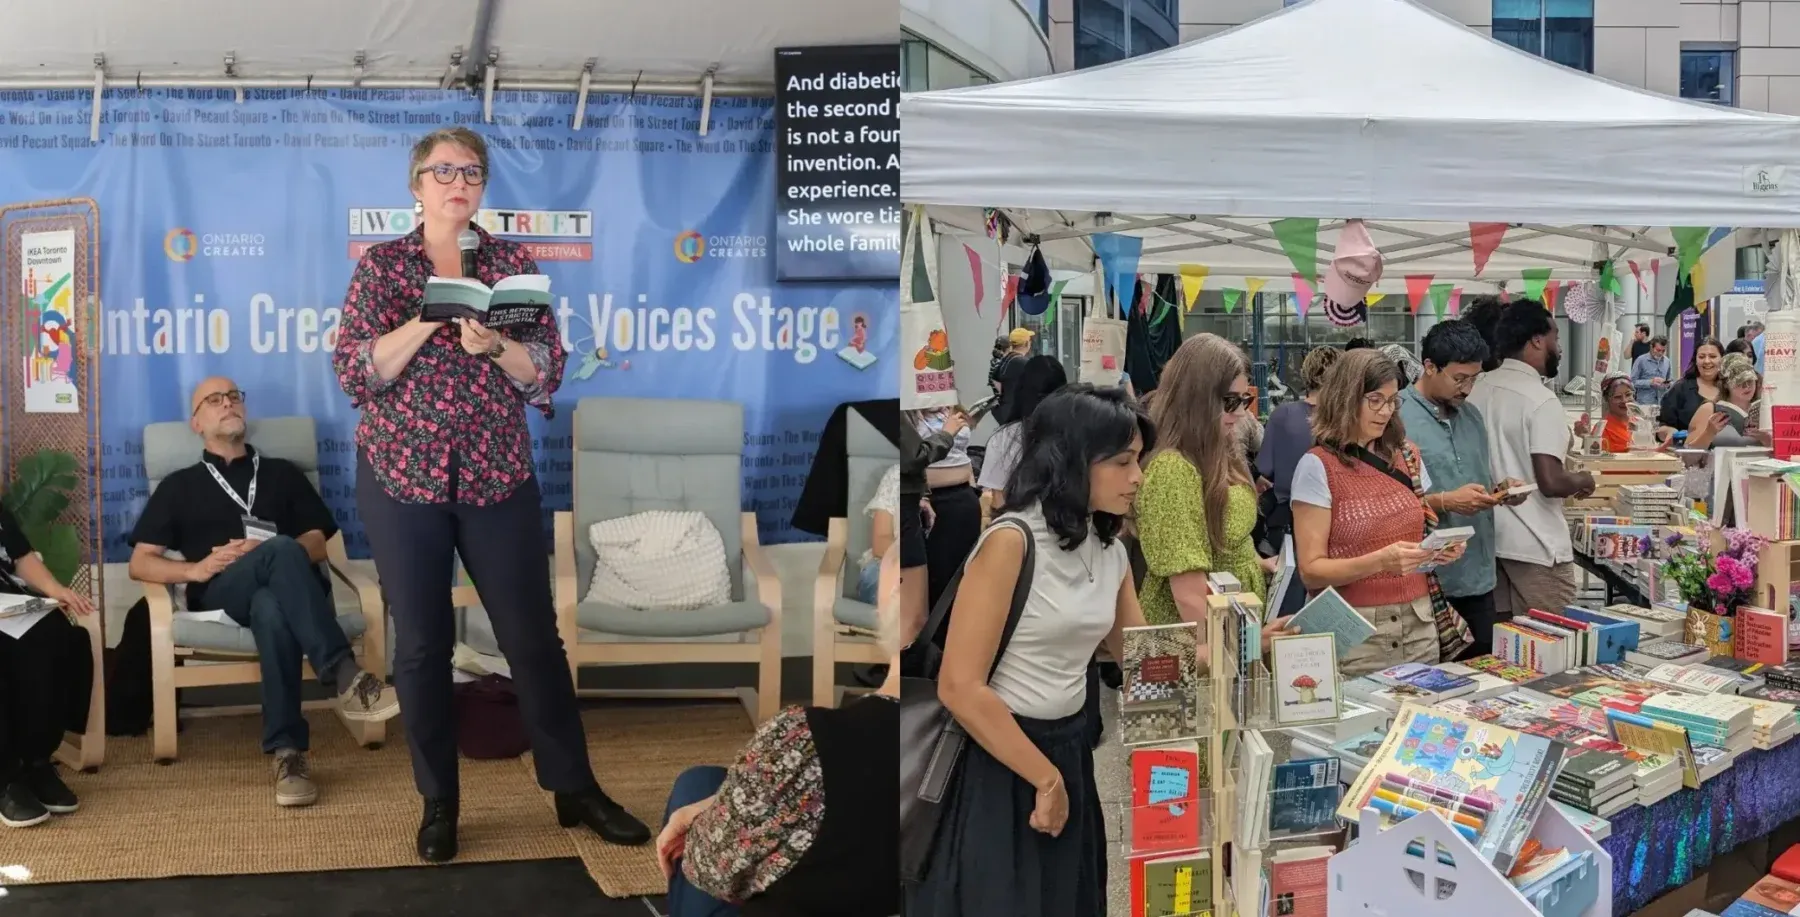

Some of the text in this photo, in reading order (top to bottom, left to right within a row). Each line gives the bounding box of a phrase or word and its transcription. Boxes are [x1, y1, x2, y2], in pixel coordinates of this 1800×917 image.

[787, 73, 824, 91] And
[0, 90, 34, 102] oronto
[47, 89, 75, 101] David
[166, 88, 184, 101] The
[187, 88, 213, 101] Word
[216, 88, 229, 101] On
[254, 88, 286, 101] Street
[339, 88, 367, 101] David
[787, 98, 890, 117] the second
[9, 111, 35, 125] Word
[39, 111, 51, 125] On
[55, 110, 73, 125] The
[77, 109, 109, 125] Stret
[113, 109, 150, 124] Toronto
[163, 109, 190, 123] David
[194, 109, 230, 123] Pecaut
[233, 109, 268, 126] Square
[281, 109, 298, 123] The
[302, 110, 328, 123] Word
[331, 110, 343, 123] On
[347, 109, 364, 123] The
[368, 109, 400, 125] Street
[403, 111, 441, 125] Toronto
[453, 111, 480, 125] David
[521, 114, 558, 129] Square
[586, 115, 609, 129] Word
[612, 115, 625, 129] On
[629, 116, 645, 130] The
[648, 116, 677, 131] Street
[728, 117, 753, 131] David
[23, 135, 58, 149] Pecaut
[109, 132, 127, 147] The
[132, 132, 156, 147] Word
[160, 132, 172, 146] On
[177, 132, 194, 146] The
[197, 132, 229, 147] Street
[233, 132, 271, 147] Toronto
[284, 132, 312, 147] David
[353, 133, 387, 150] Square
[520, 135, 556, 151] Toronto
[566, 136, 592, 152] David
[633, 138, 665, 154] Square
[675, 138, 692, 152] The
[696, 138, 720, 153] Word
[723, 139, 736, 153] On
[739, 138, 756, 153] The
[787, 127, 802, 145] is
[807, 128, 839, 144] not
[844, 130, 855, 143] a
[787, 154, 881, 172] invention.
[787, 180, 897, 202] experience.
[351, 210, 411, 232] THE WO
[484, 209, 588, 234] STREET
[787, 208, 821, 226] She
[827, 210, 874, 225] wore
[203, 233, 265, 246] ONTARIO
[709, 235, 767, 247] ONTARIO
[787, 234, 844, 253] whole
[27, 246, 68, 256] IKEA Toronto
[203, 245, 265, 257] CREATES
[536, 246, 582, 258] FESTIVAL
[709, 246, 767, 258] CREATES
[27, 256, 62, 265] Downtown
[251, 293, 341, 355] Crea
[499, 312, 535, 320] STRICTLY
[588, 292, 716, 352] Voices
[733, 292, 841, 364] Stage
[1764, 348, 1797, 356] HEAVY
[118, 464, 133, 479] On
